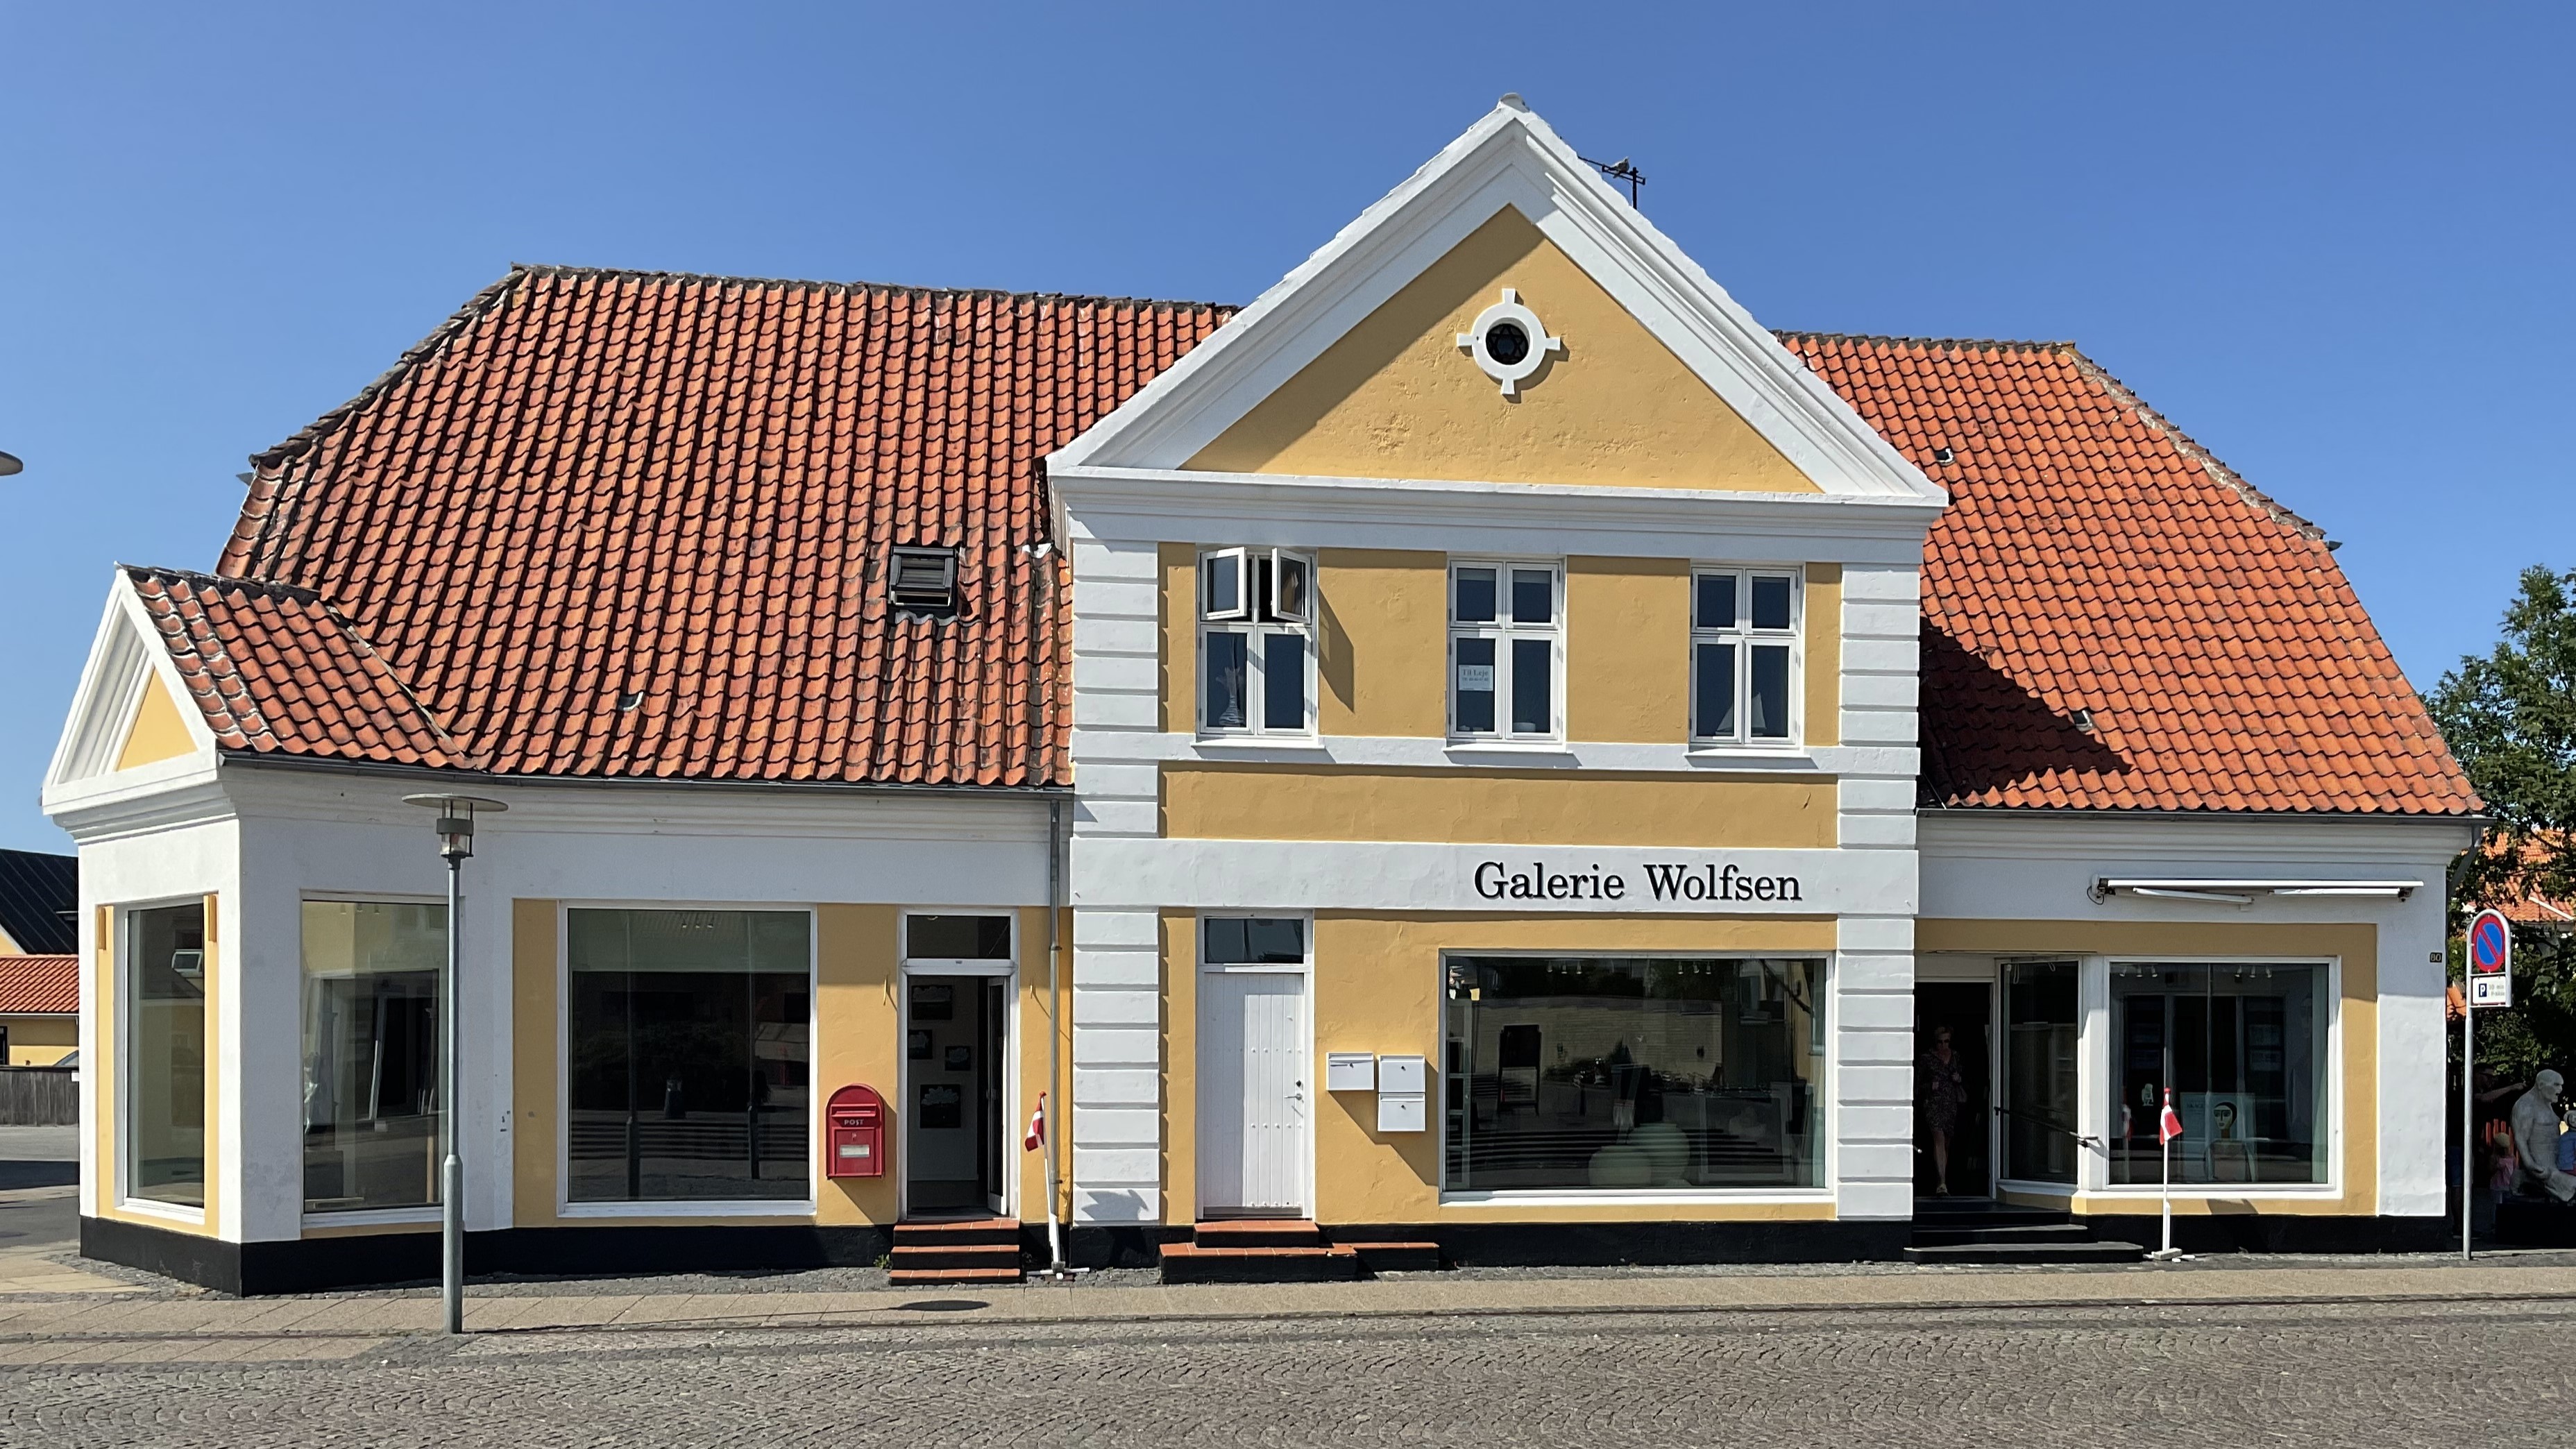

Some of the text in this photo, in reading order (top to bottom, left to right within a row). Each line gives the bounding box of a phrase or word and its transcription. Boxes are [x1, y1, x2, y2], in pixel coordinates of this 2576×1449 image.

[1474, 861, 1803, 901] Galerie Wolfsen
[2480, 985, 2486, 997] P
